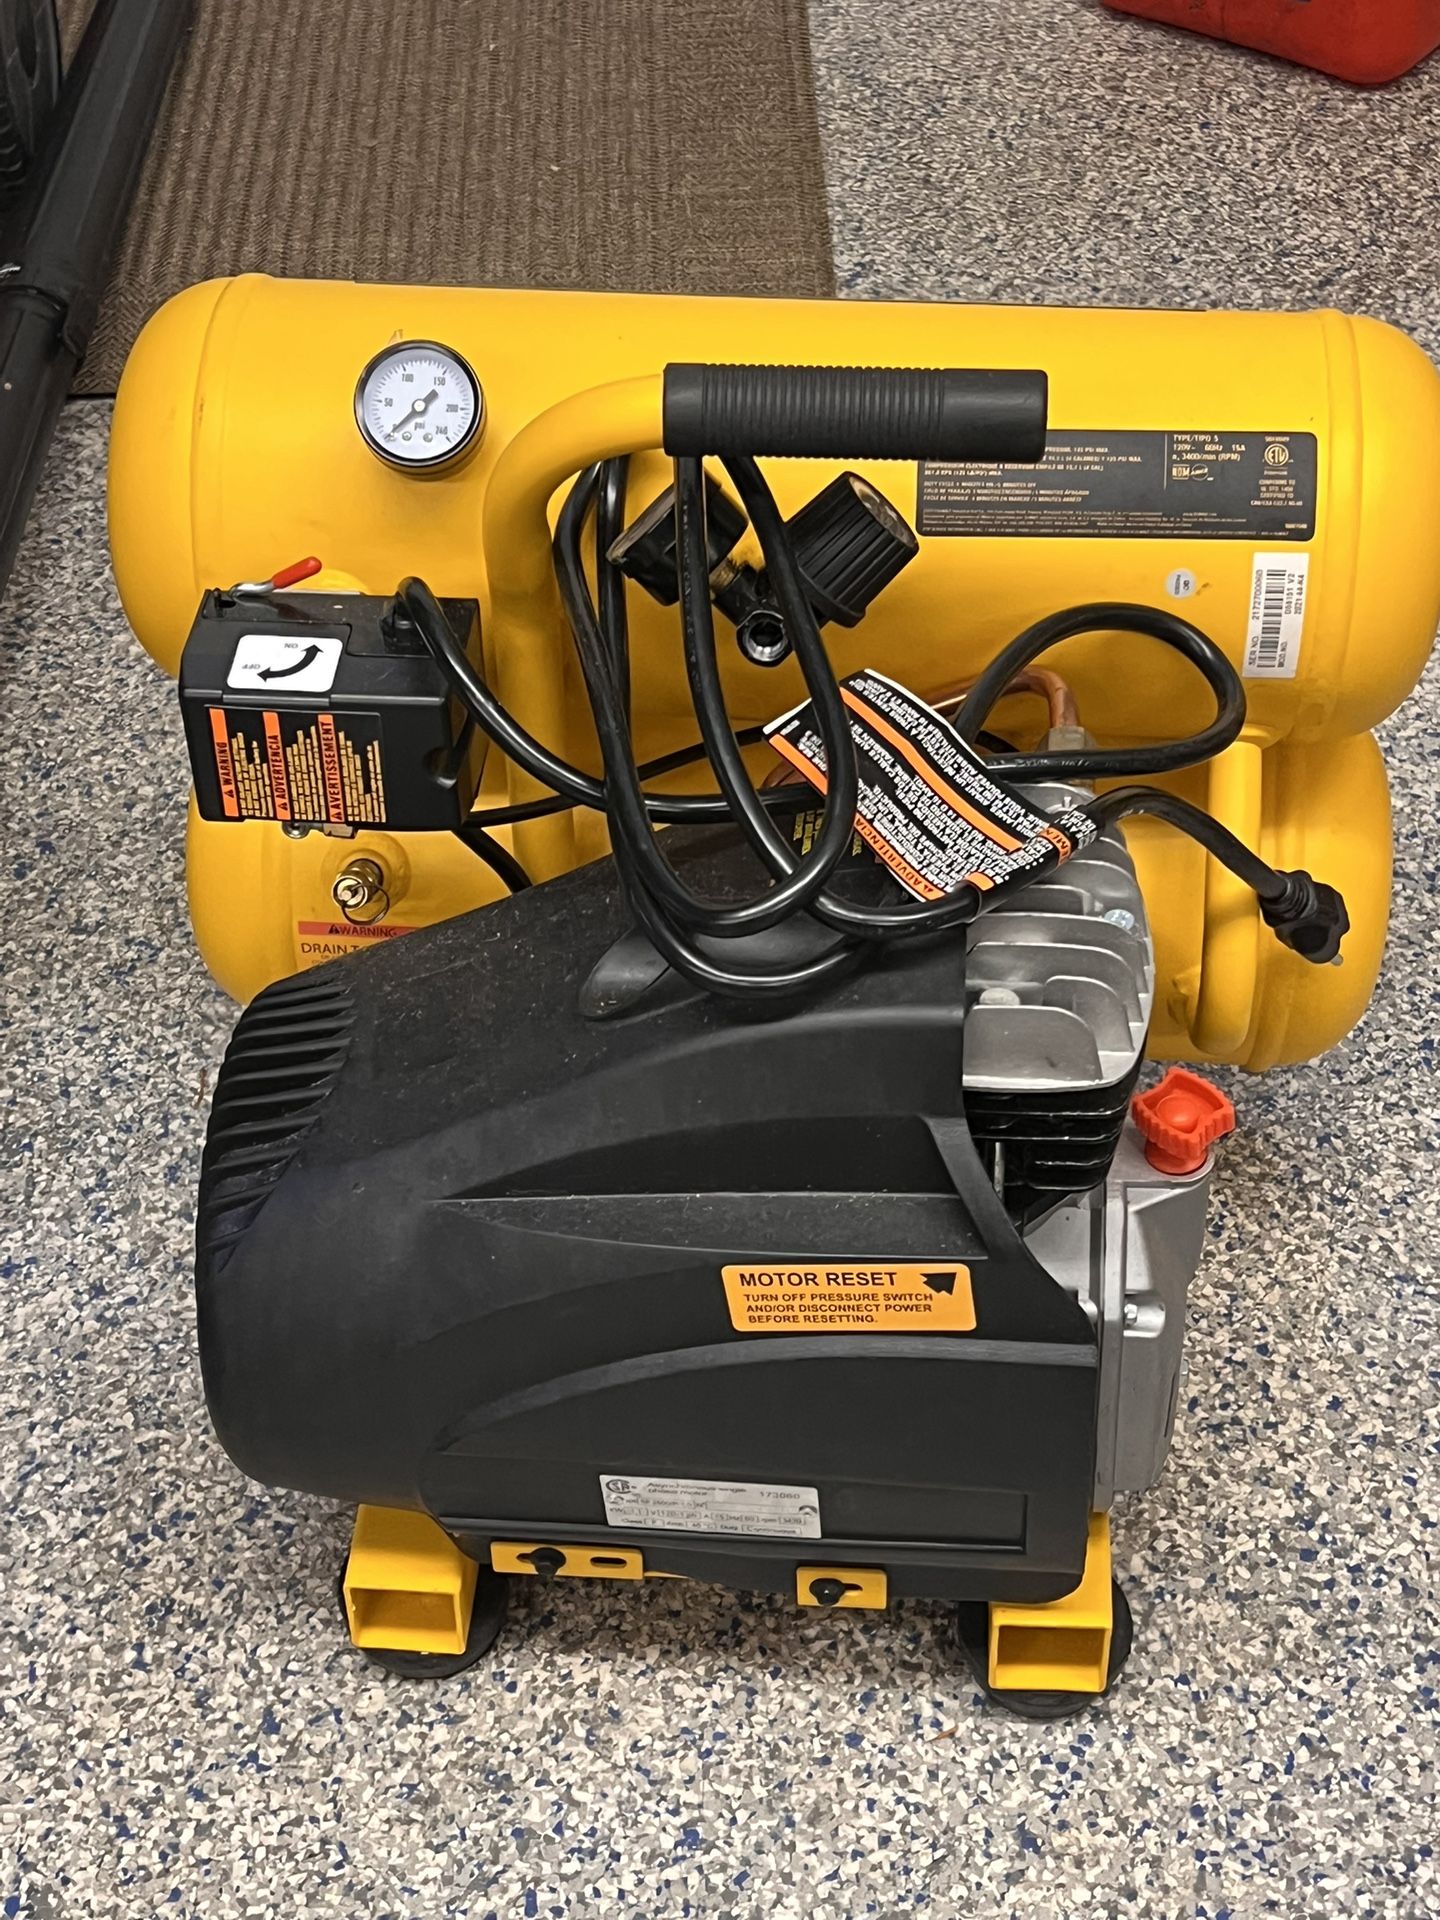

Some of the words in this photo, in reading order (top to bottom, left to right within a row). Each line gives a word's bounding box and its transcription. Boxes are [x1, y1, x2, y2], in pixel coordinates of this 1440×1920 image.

[401, 373, 414, 383] 100
[433, 377, 446, 386] 150
[384, 398, 393, 407] 50
[446, 404, 459, 413] 200
[217, 741, 233, 786] WARNING
[268, 733, 287, 801] ADVERTENCIA
[320, 720, 341, 811] AVERTISSEMENT
[854, 817, 922, 887] ADVERTENCIA
[301, 942, 348, 954] DRAIN
[739, 1272, 820, 1287] MOTOR
[826, 1272, 898, 1286] RESET
[744, 1294, 779, 1302] TURN
[782, 1294, 807, 1302] OFF
[810, 1293, 880, 1302] PRESSURE
[883, 1293, 933, 1302] SWITCH
[746, 1304, 796, 1313] AND/OR
[798, 1304, 881, 1313] DISCONNECT
[884, 1303, 933, 1312] POWER
[748, 1315, 800, 1324] BEFORE
[803, 1314, 879, 1323] RESETTING.
